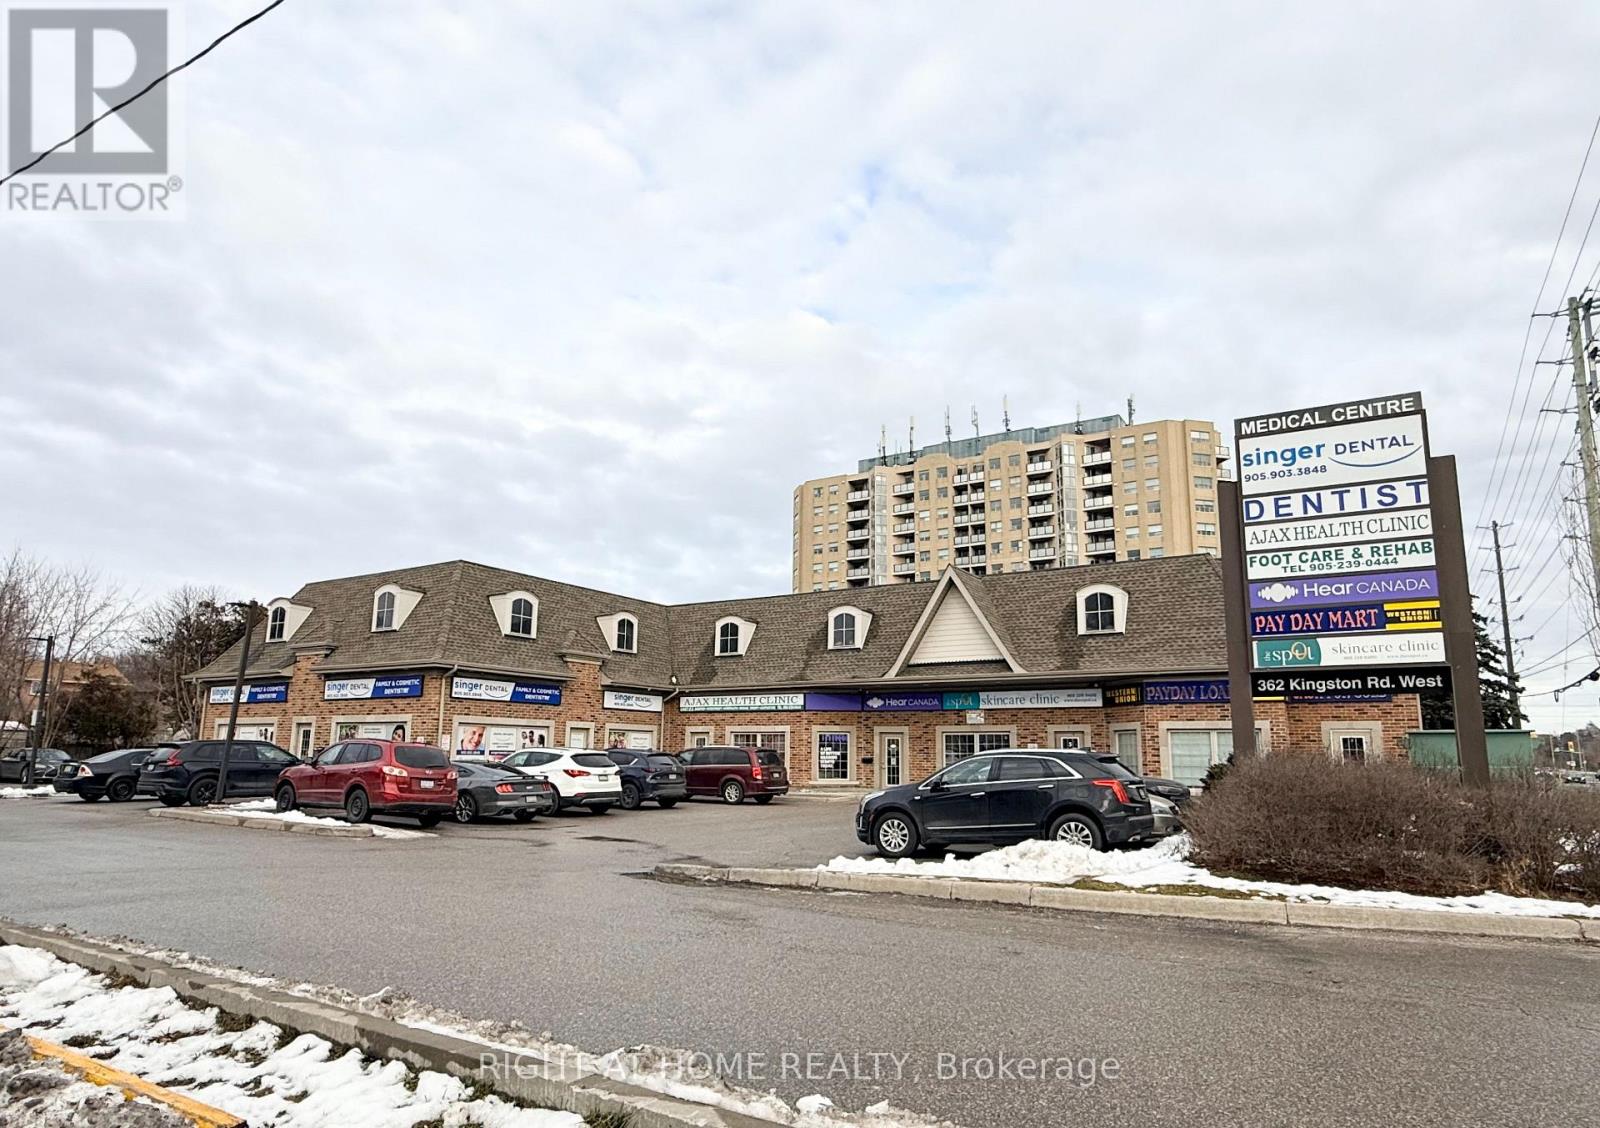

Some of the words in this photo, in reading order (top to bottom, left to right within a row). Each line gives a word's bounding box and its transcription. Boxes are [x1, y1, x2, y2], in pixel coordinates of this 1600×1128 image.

[1240, 412, 1326, 436] MEDICAL
[1331, 397, 1415, 422] CENTRE
[1242, 442, 1326, 467] singer
[1334, 434, 1414, 456] DENTAL
[1244, 464, 1328, 483] 905.903.3848
[1245, 481, 1427, 521] DENTIST
[1249, 527, 1292, 546] AJAX
[1294, 520, 1365, 540] HEALTH
[1366, 514, 1430, 534] CLINIC
[1249, 553, 1293, 568] FOOT
[1298, 548, 1345, 564] CARE
[1351, 547, 1364, 559] &
[1370, 541, 1433, 558] REHAB
[1281, 565, 1307, 574] TEL
[1309, 557, 1399, 572] 905-239-0444
[1303, 580, 1353, 598] Hear
[1356, 578, 1431, 595] CANADA
[1255, 614, 1286, 633] PAY
[1290, 611, 1325, 630] DAY
[1328, 608, 1379, 629] MART
[1386, 610, 1430, 619] WESTERN
[1400, 615, 1430, 623] UNION
[1332, 643, 1394, 655] skincare
[1398, 639, 1440, 652] clinic
[455, 681, 483, 692] singer
[1257, 679, 1286, 692] 362
[1289, 676, 1363, 693] Kingston
[1367, 673, 1396, 689] Rd.
[1400, 674, 1443, 688] West
[684, 698, 709, 706] AJAX
[713, 696, 756, 705] HEALTH
[760, 695, 799, 704] CLINIC
[981, 694, 1026, 706] skincare
[1029, 693, 1060, 704] clinic
[1106, 688, 1136, 697] WESTERN
[1115, 695, 1136, 703] UNION
[1147, 686, 1196, 700] PAYDAY
